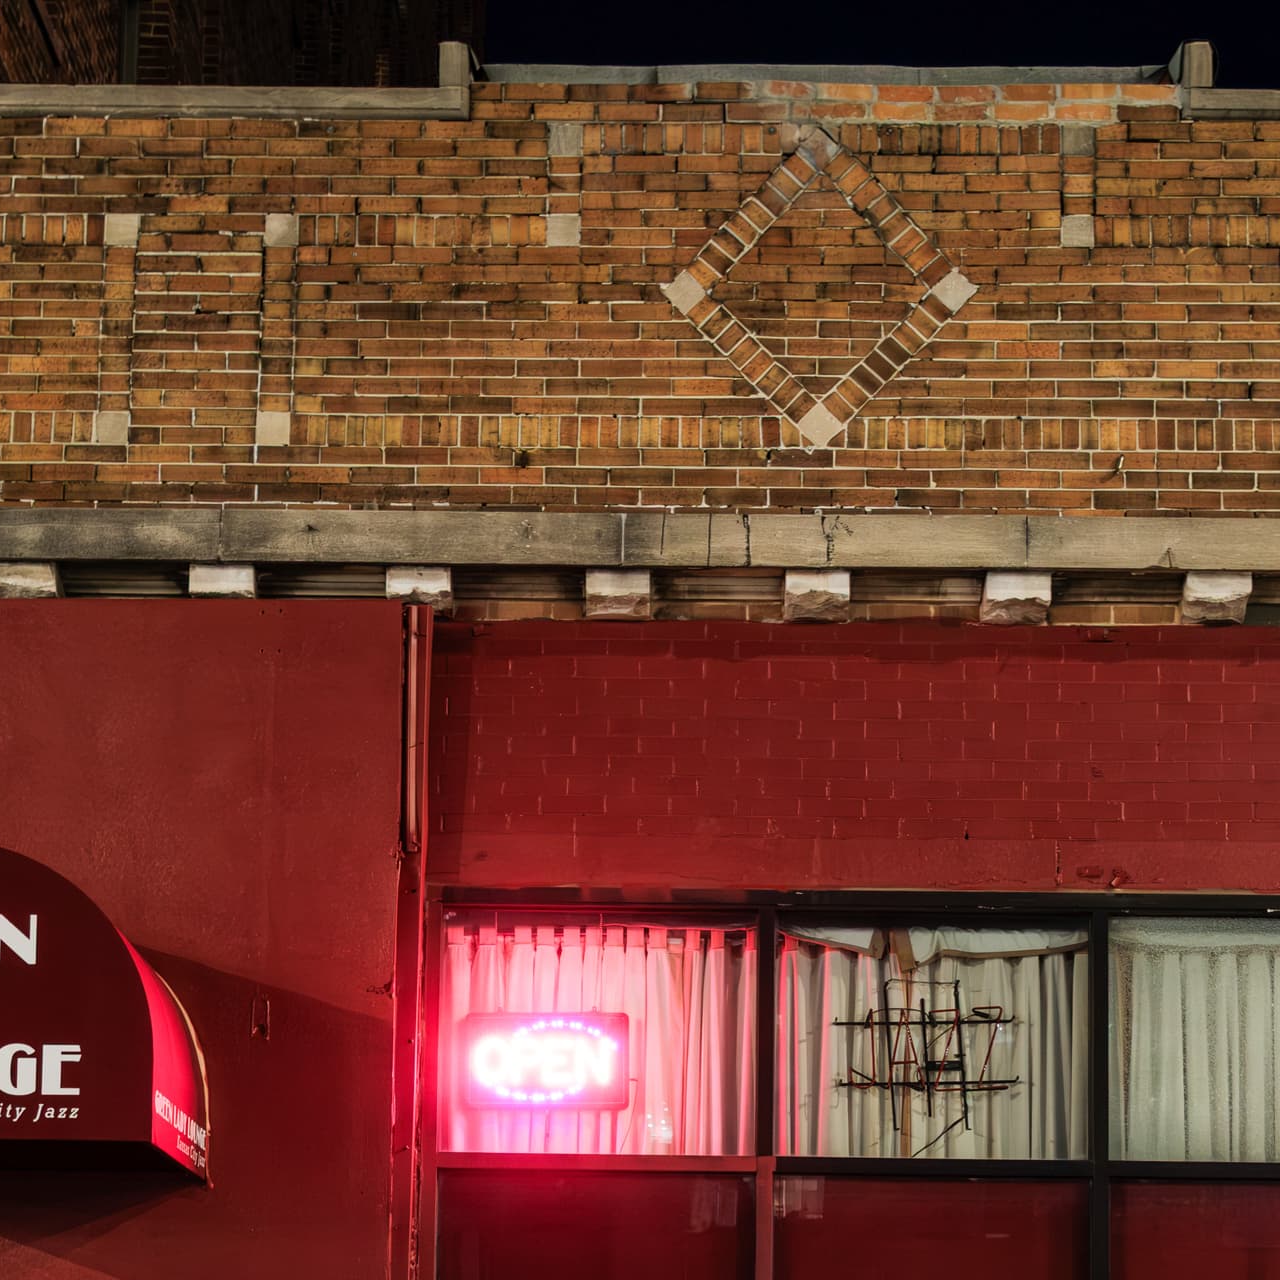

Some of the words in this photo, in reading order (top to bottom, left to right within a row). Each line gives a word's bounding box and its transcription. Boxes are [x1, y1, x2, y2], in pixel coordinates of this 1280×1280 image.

[471, 1035, 613, 1086] OPEN
[33, 1102, 80, 1123] Jazz
[155, 1090, 173, 1125] GREEN
[173, 1105, 187, 1135] LADY
[187, 1117, 206, 1151] LOUNGE
